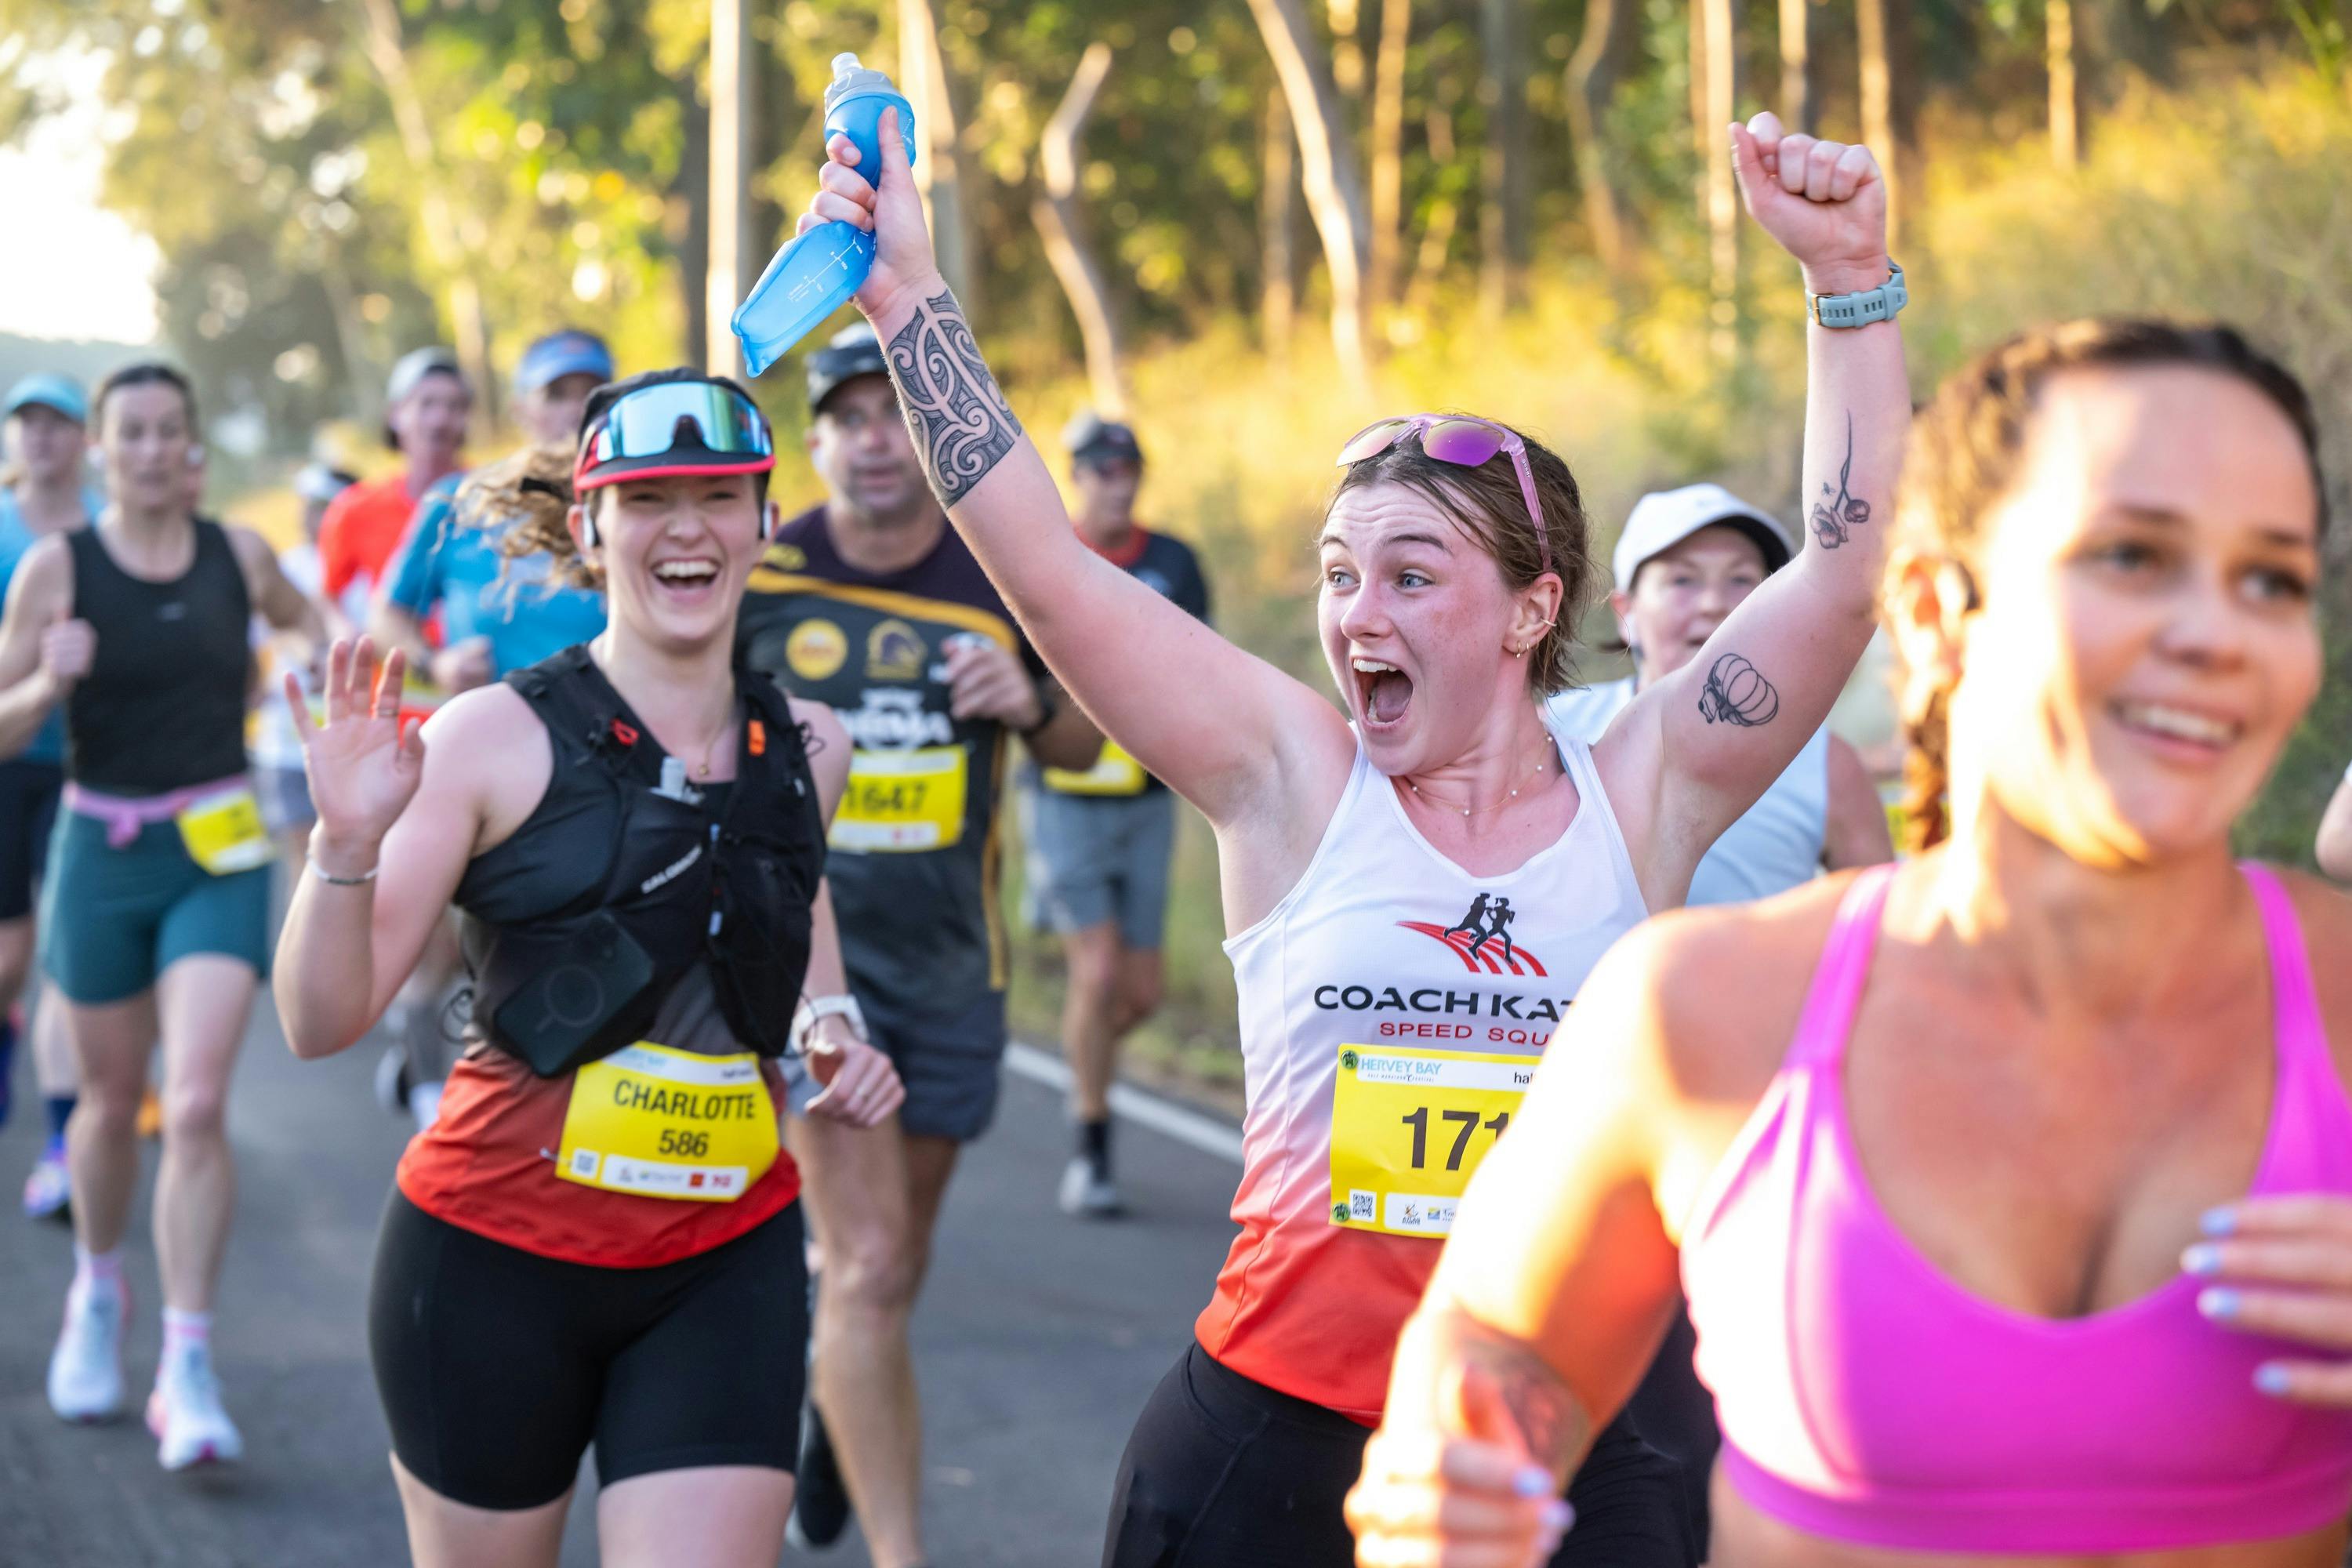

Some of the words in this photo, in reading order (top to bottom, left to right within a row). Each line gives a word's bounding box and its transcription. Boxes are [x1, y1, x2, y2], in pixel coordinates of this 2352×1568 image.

[1314, 985, 1479, 1014] COACH
[1380, 1022, 1472, 1039] SPEED
[1488, 1028, 1549, 1046] SQU
[1361, 1058, 1413, 1073] HERVEY
[1416, 1062, 1442, 1075] BAY
[614, 1080, 756, 1120] CHARLOTTE
[658, 1129, 710, 1157] 586
